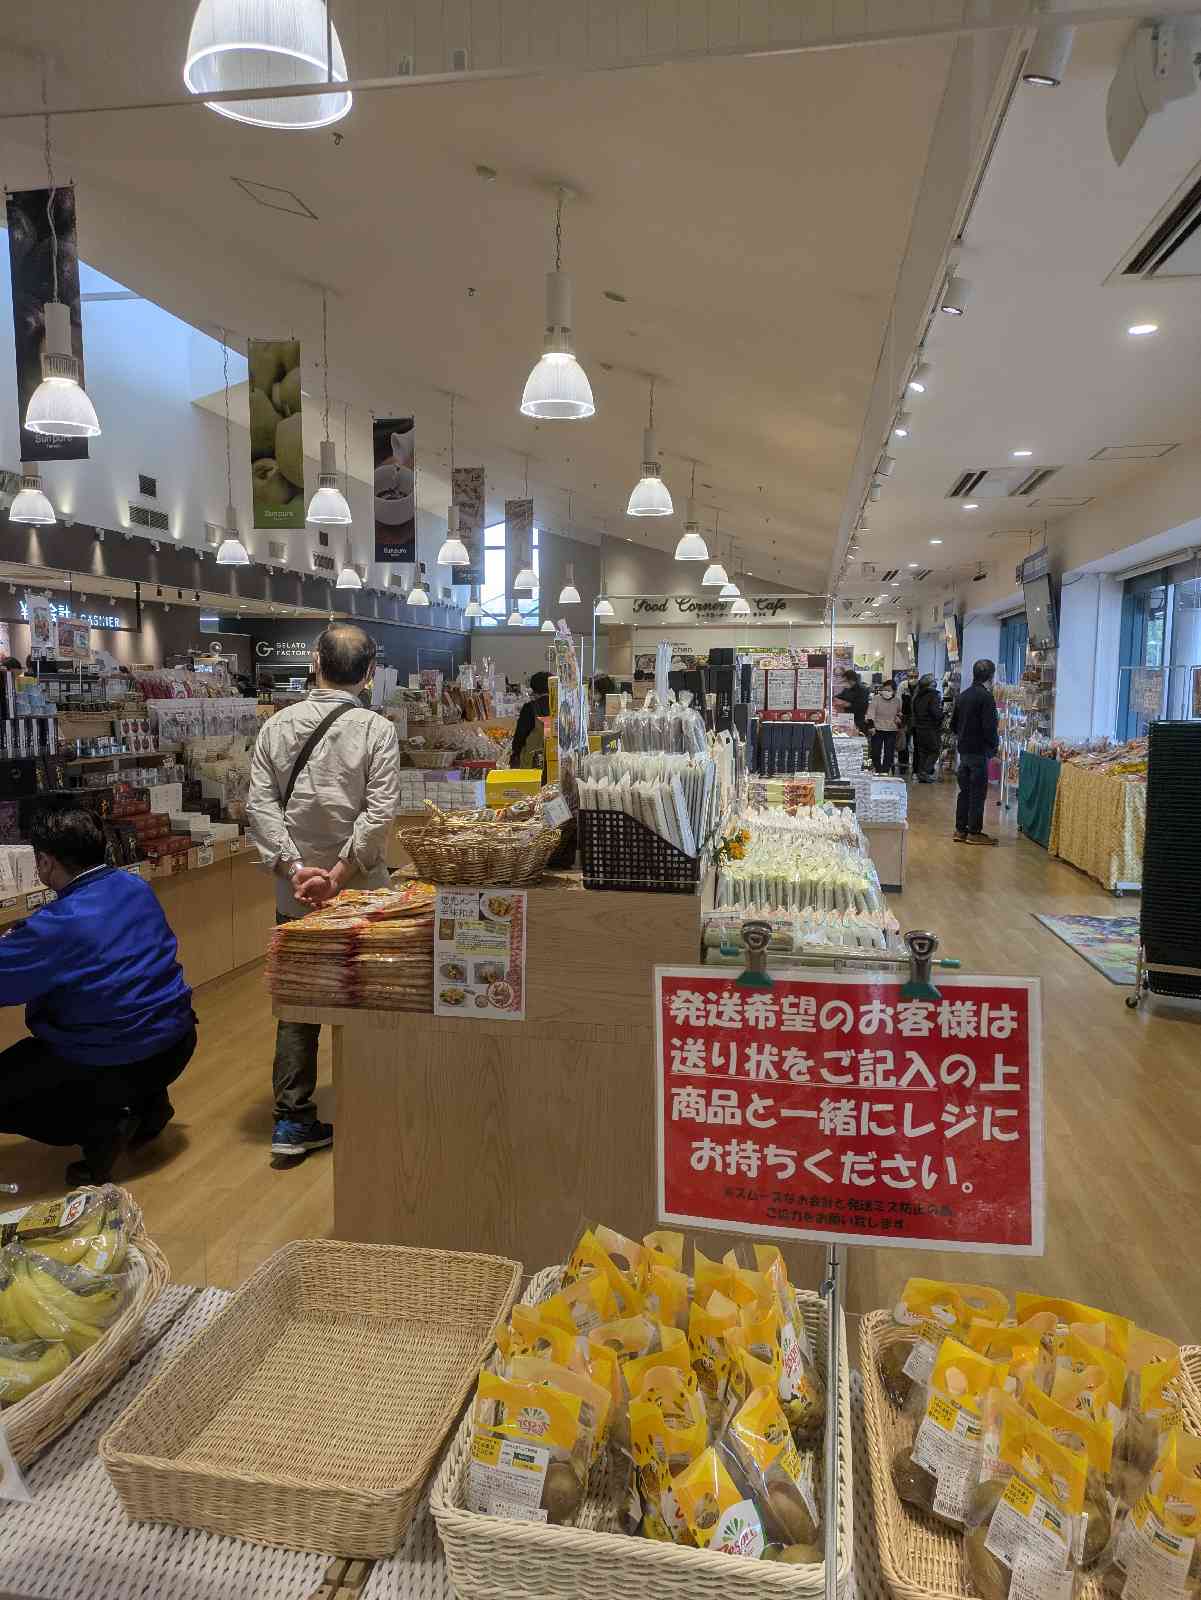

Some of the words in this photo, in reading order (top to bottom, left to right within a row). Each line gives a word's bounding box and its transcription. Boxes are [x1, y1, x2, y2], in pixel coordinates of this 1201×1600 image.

[632, 598, 669, 613] Food
[753, 598, 787, 616] Cafe
[669, 989, 1018, 1039] 発送希望のお客様は
[670, 1038, 1021, 1092] 送り状をご記入の上
[671, 1085, 1021, 1142] 商品と一緒にレジに
[690, 1136, 974, 1194] お持ちください。
